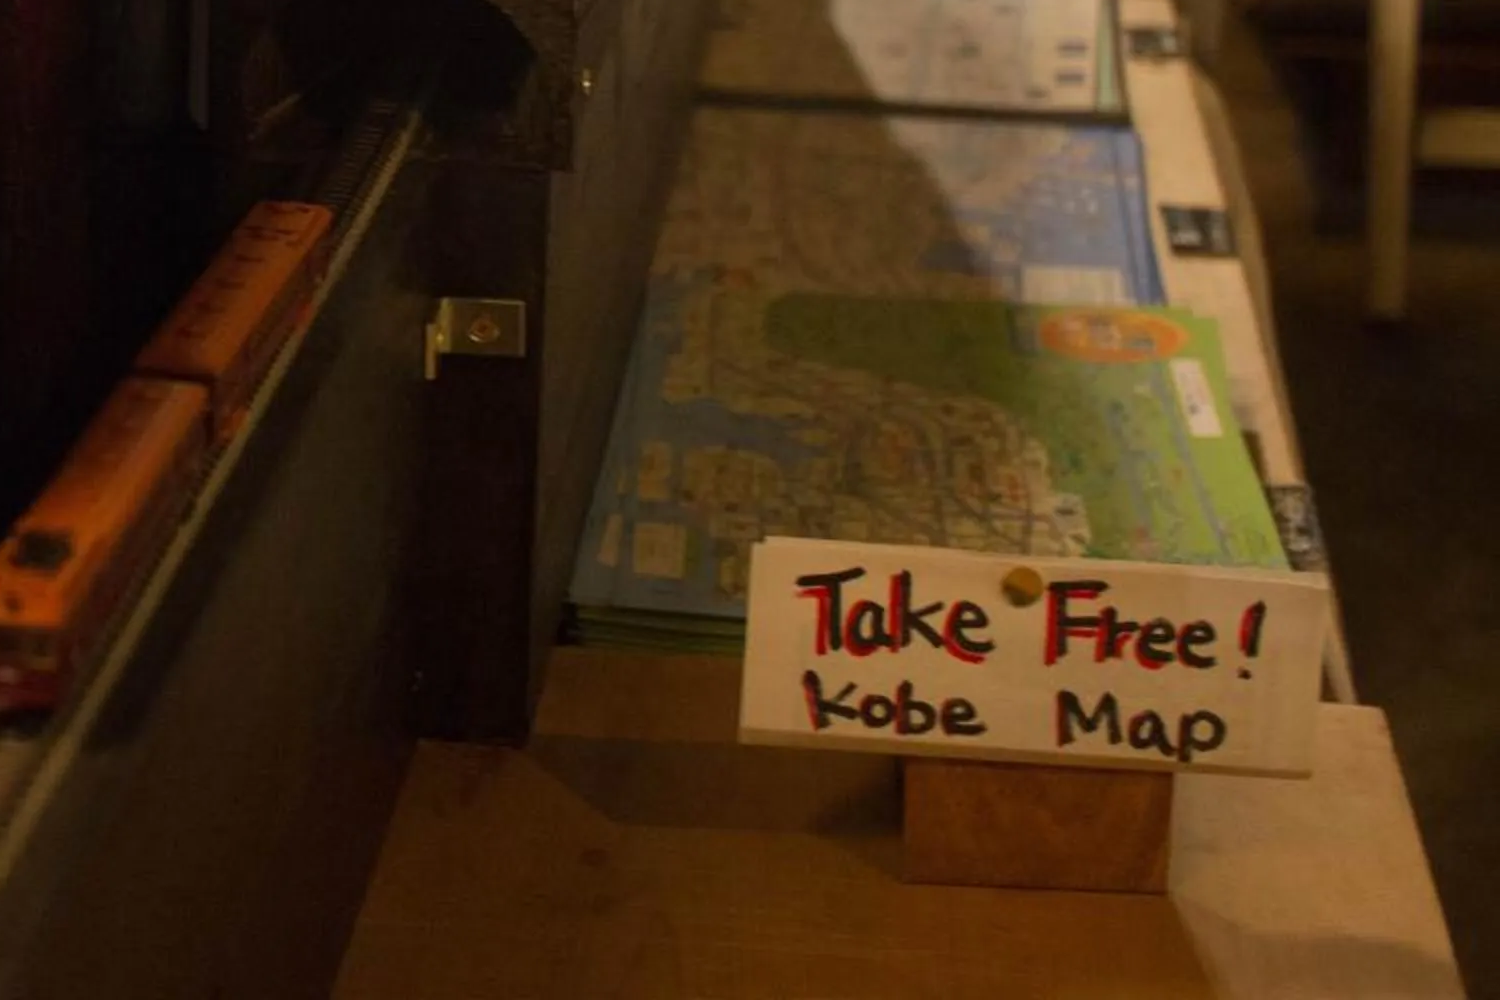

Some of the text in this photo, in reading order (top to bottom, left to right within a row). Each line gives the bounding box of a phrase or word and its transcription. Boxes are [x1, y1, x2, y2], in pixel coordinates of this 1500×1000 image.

[795, 567, 995, 664] Take
[802, 669, 1227, 763] Kobe Map
